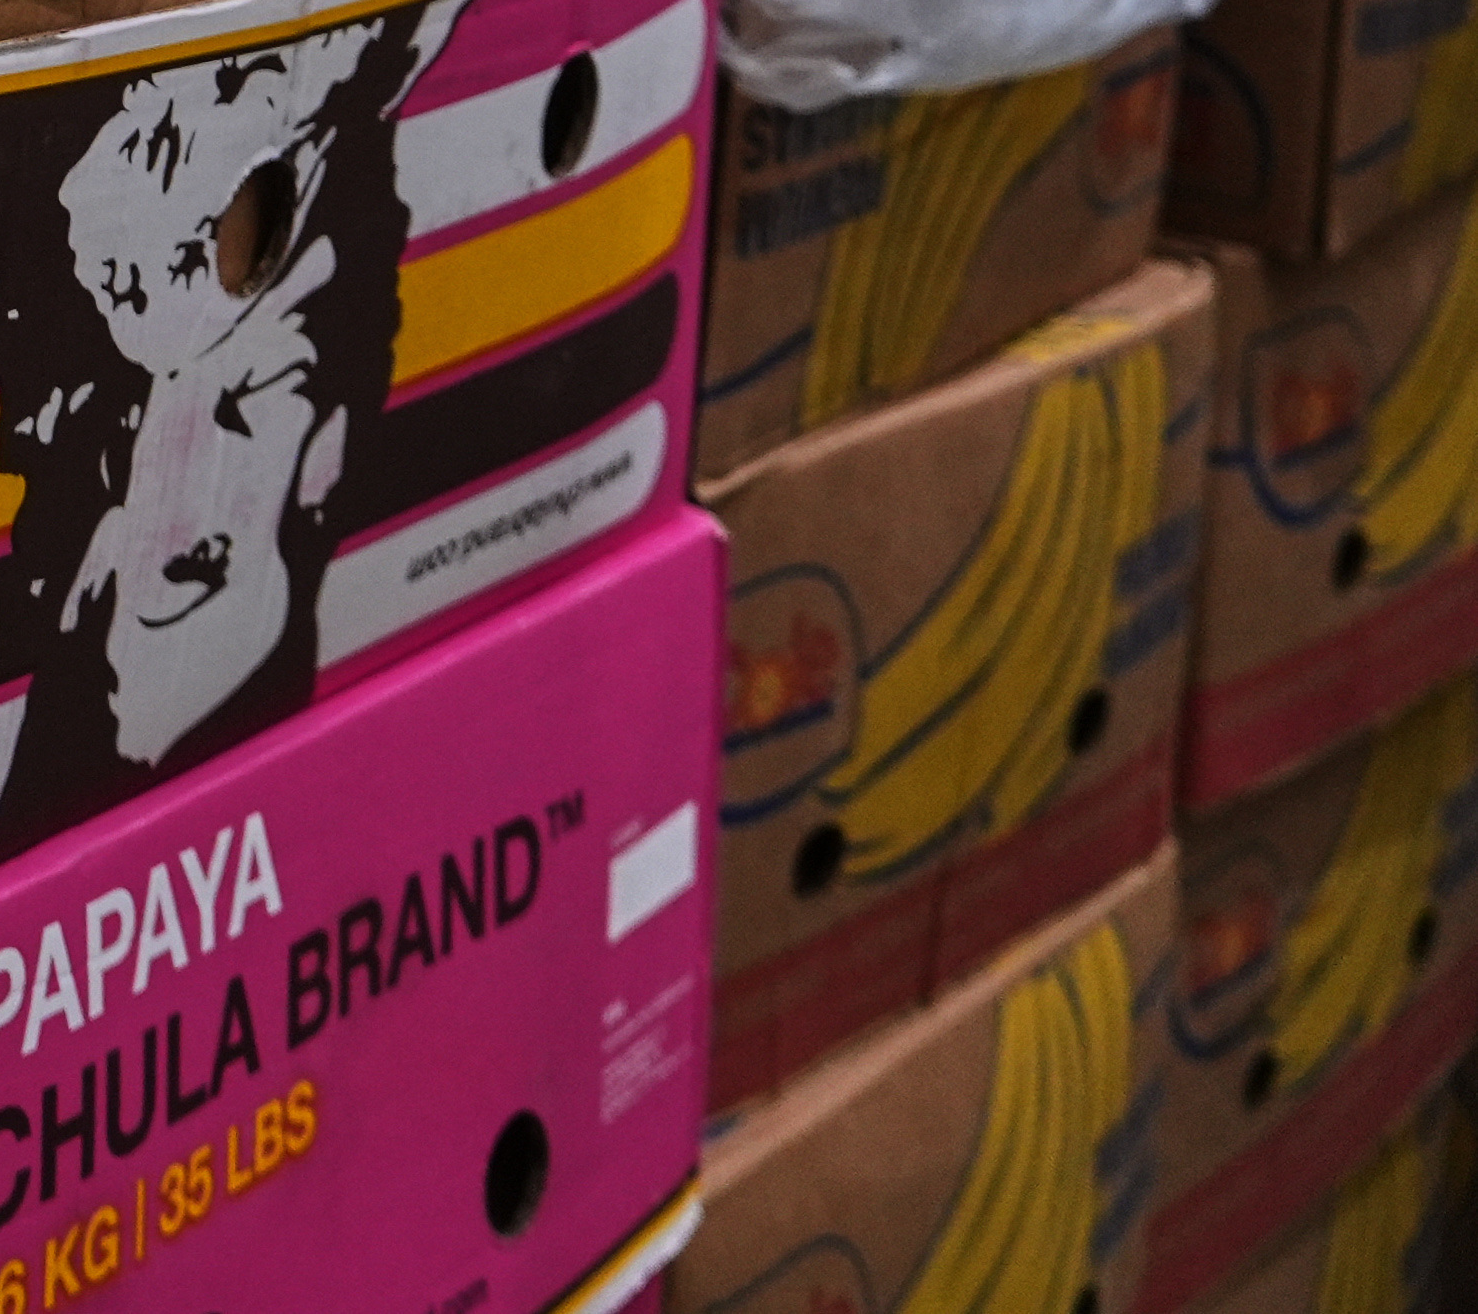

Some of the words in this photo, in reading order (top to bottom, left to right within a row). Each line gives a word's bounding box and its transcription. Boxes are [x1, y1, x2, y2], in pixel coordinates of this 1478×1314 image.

[44, 1203, 120, 1309] KG
[159, 1144, 214, 1240] 35
[227, 1079, 317, 1196] LBS
